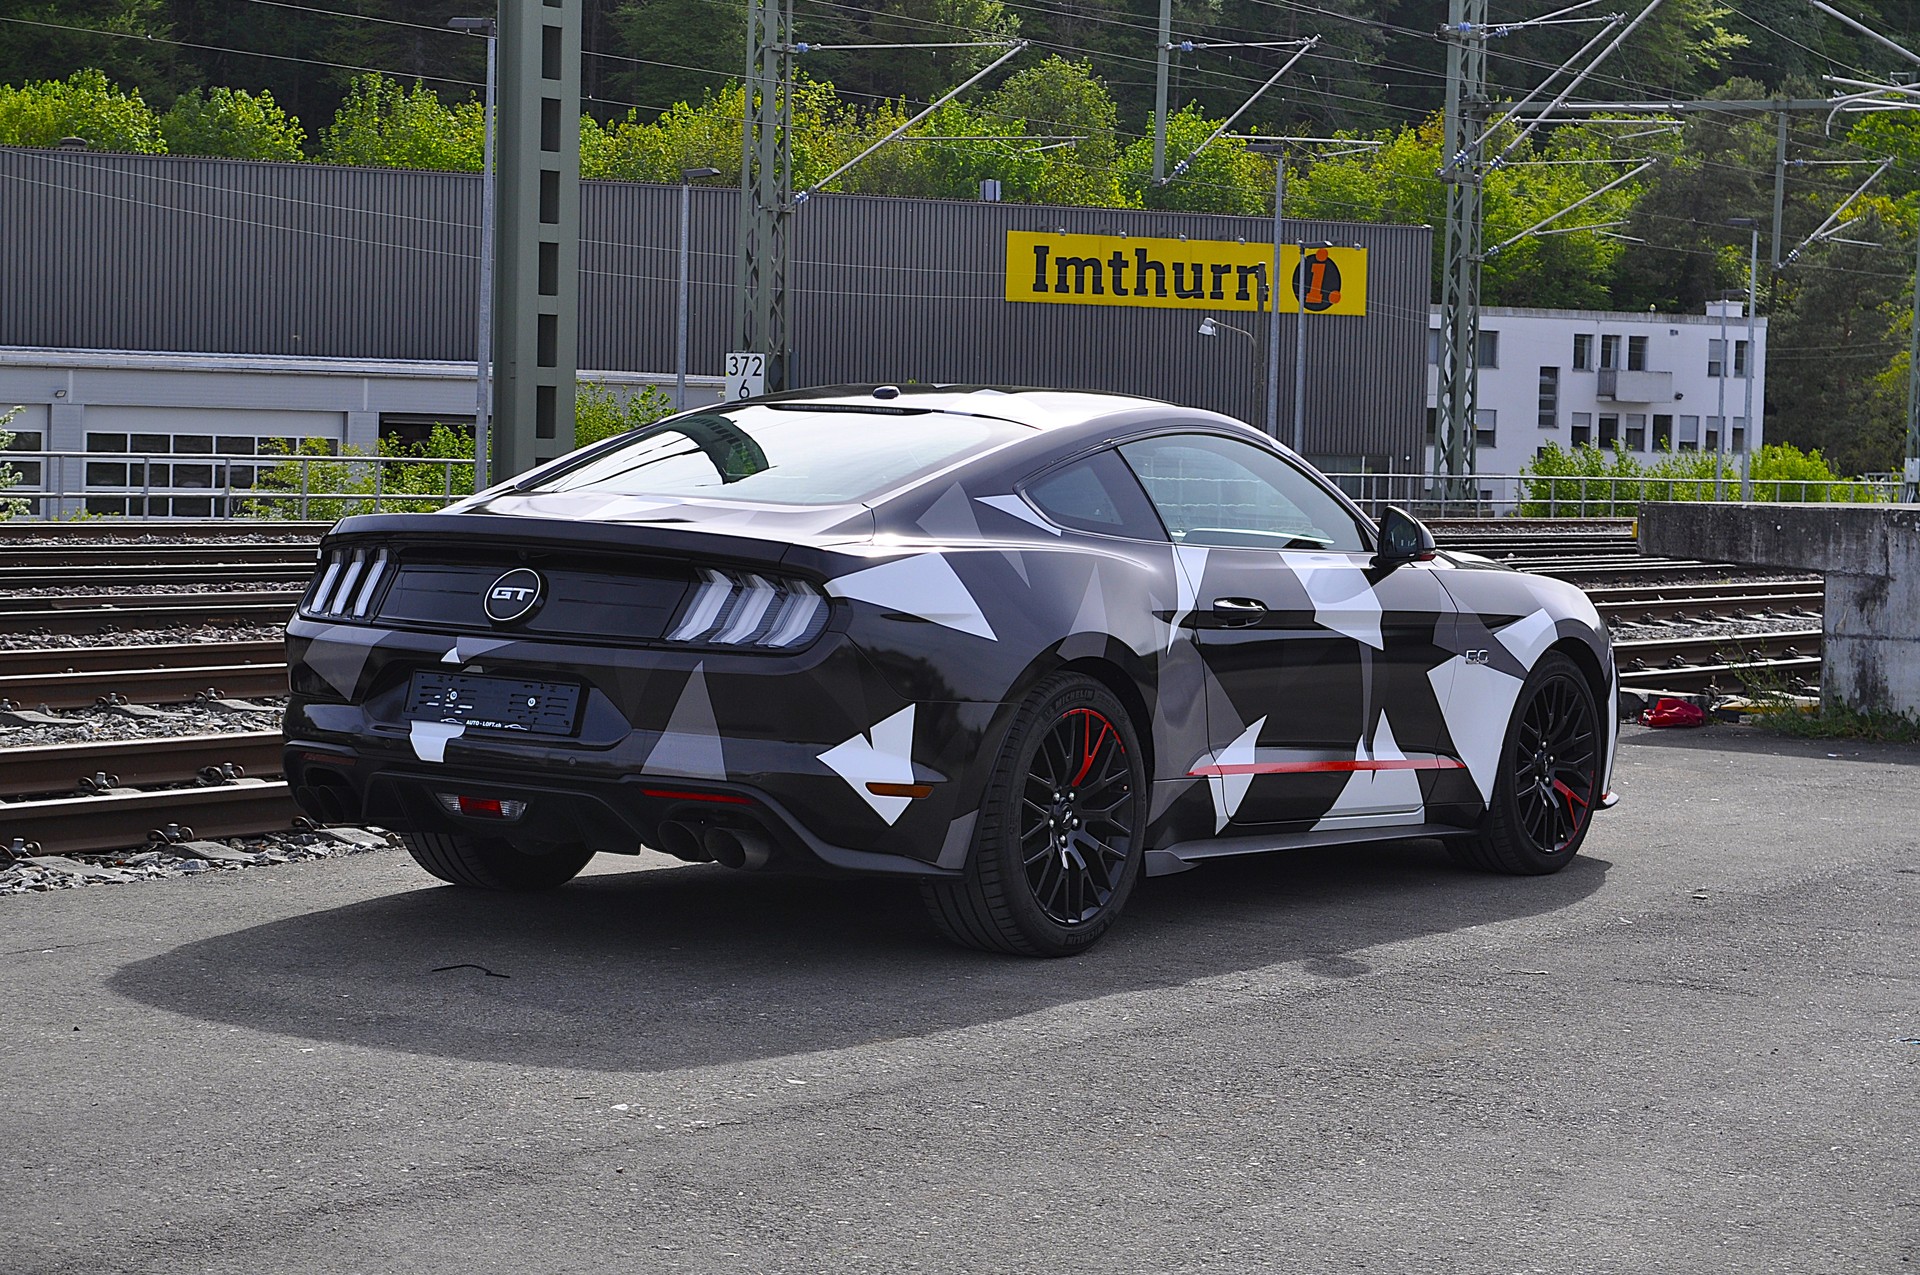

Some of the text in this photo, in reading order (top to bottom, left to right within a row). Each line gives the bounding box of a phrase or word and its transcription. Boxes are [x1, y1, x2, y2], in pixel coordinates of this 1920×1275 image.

[1032, 245, 1268, 301] Imthurn
[728, 356, 763, 376] 372
[738, 379, 750, 399] 6
[491, 586, 535, 601] GT
[1055, 689, 1094, 708] MICHELIN
